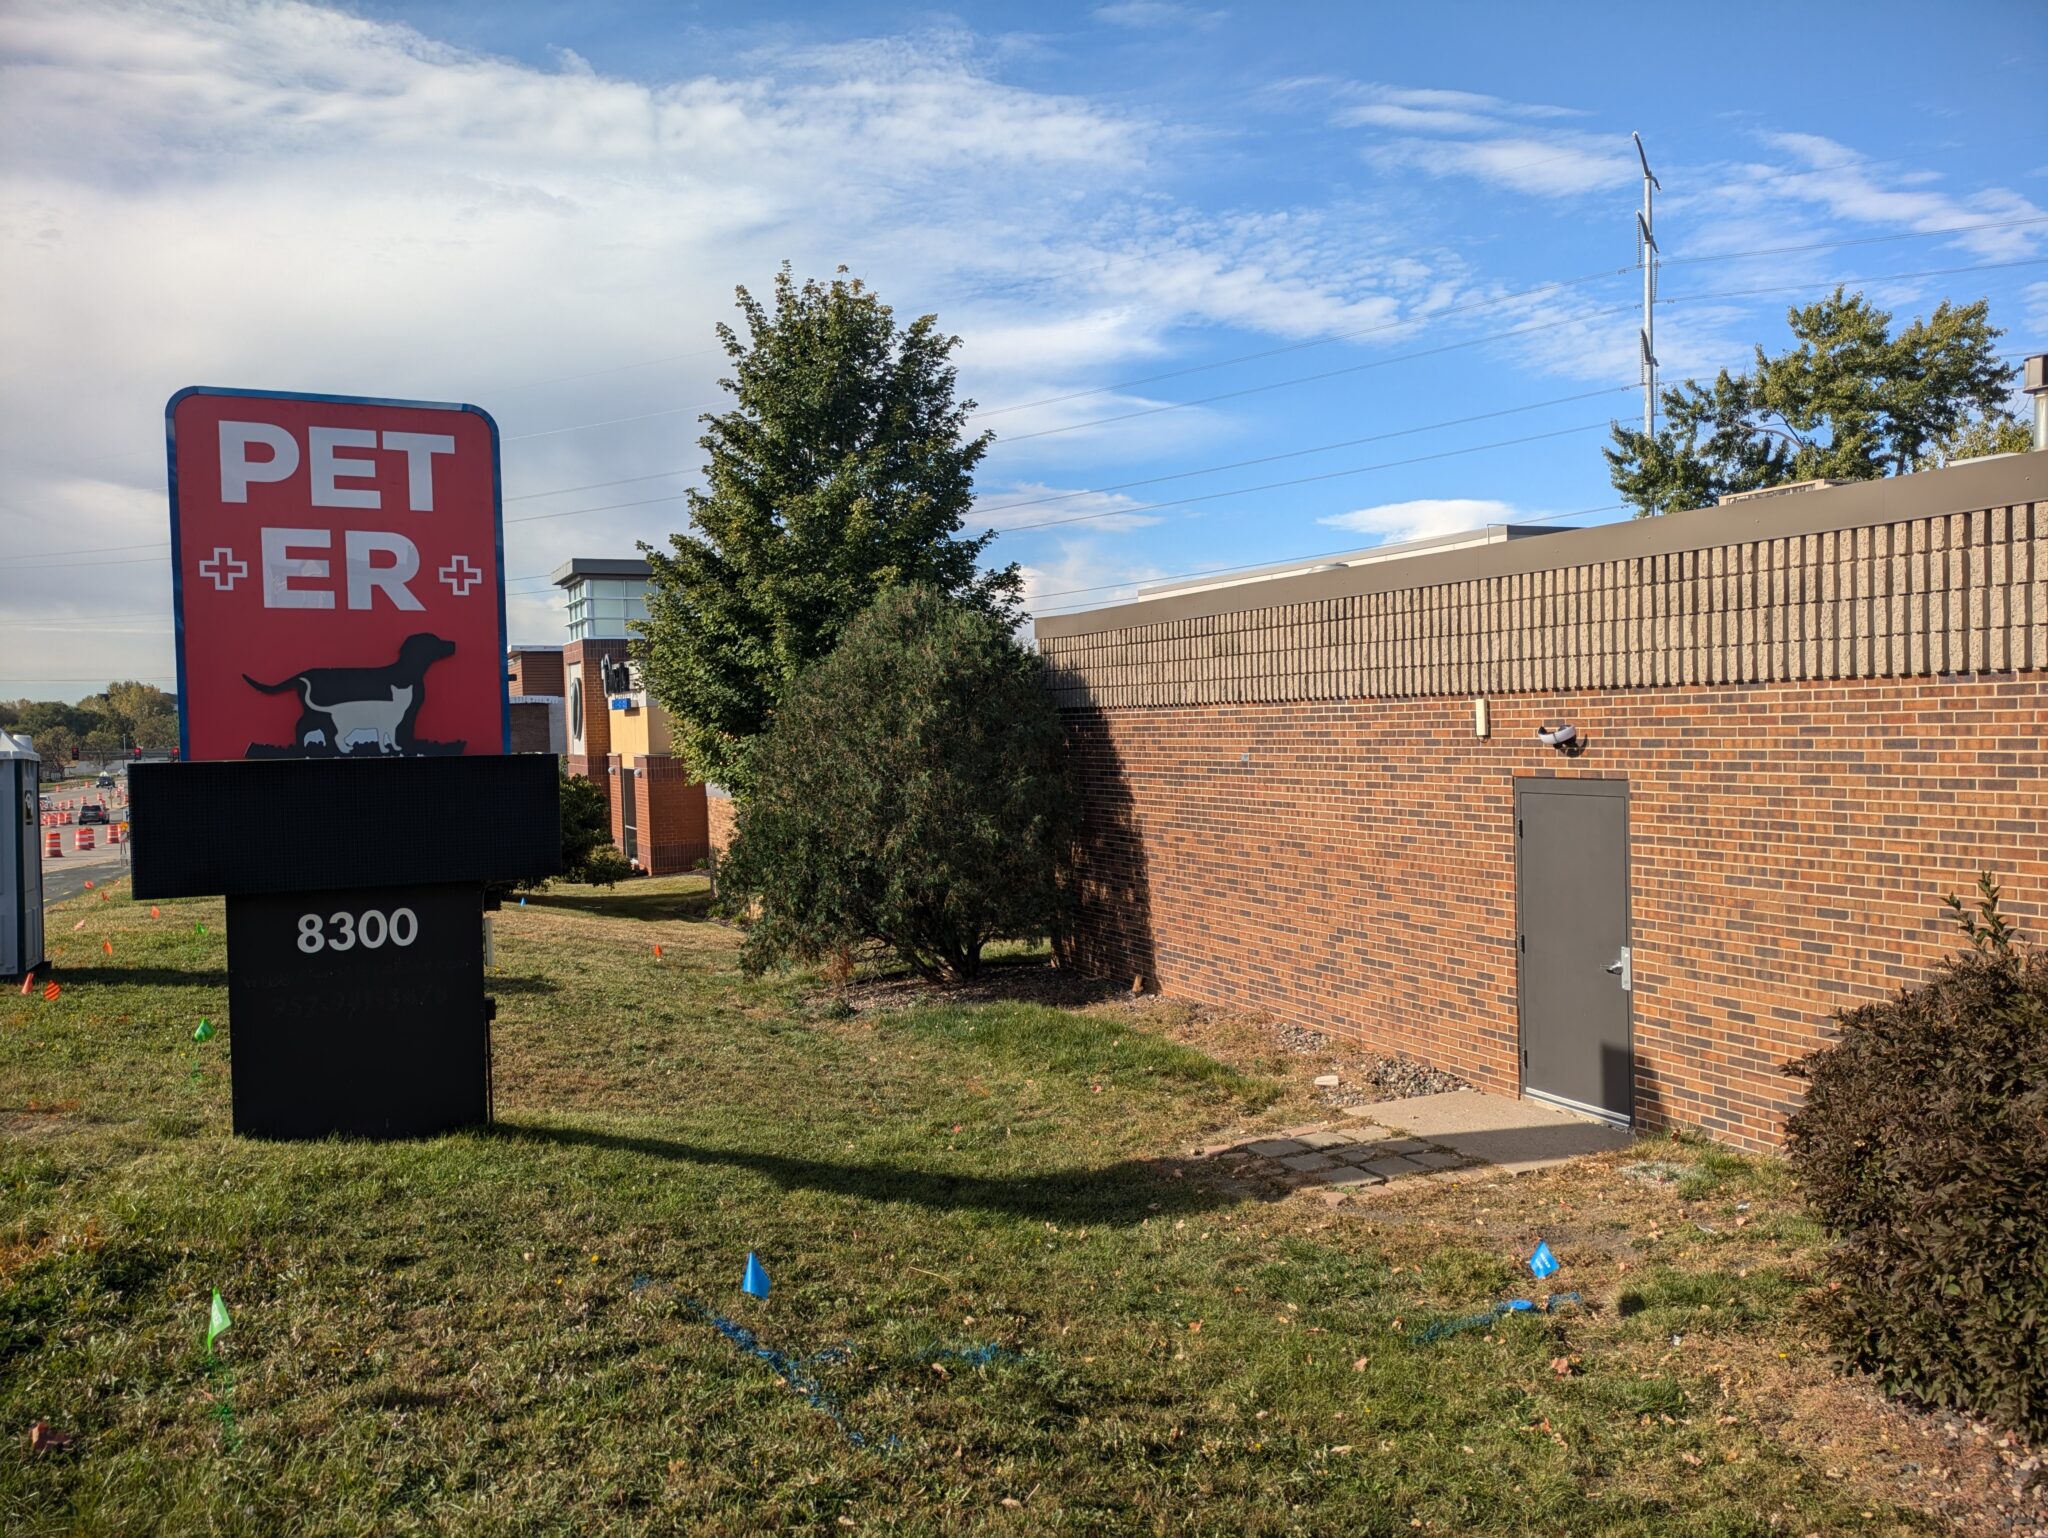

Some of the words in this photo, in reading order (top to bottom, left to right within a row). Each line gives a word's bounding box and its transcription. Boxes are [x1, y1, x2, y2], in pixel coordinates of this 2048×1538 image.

[218, 420, 455, 511] PET
[261, 527, 426, 611] ER
[297, 907, 418, 953] 8300
